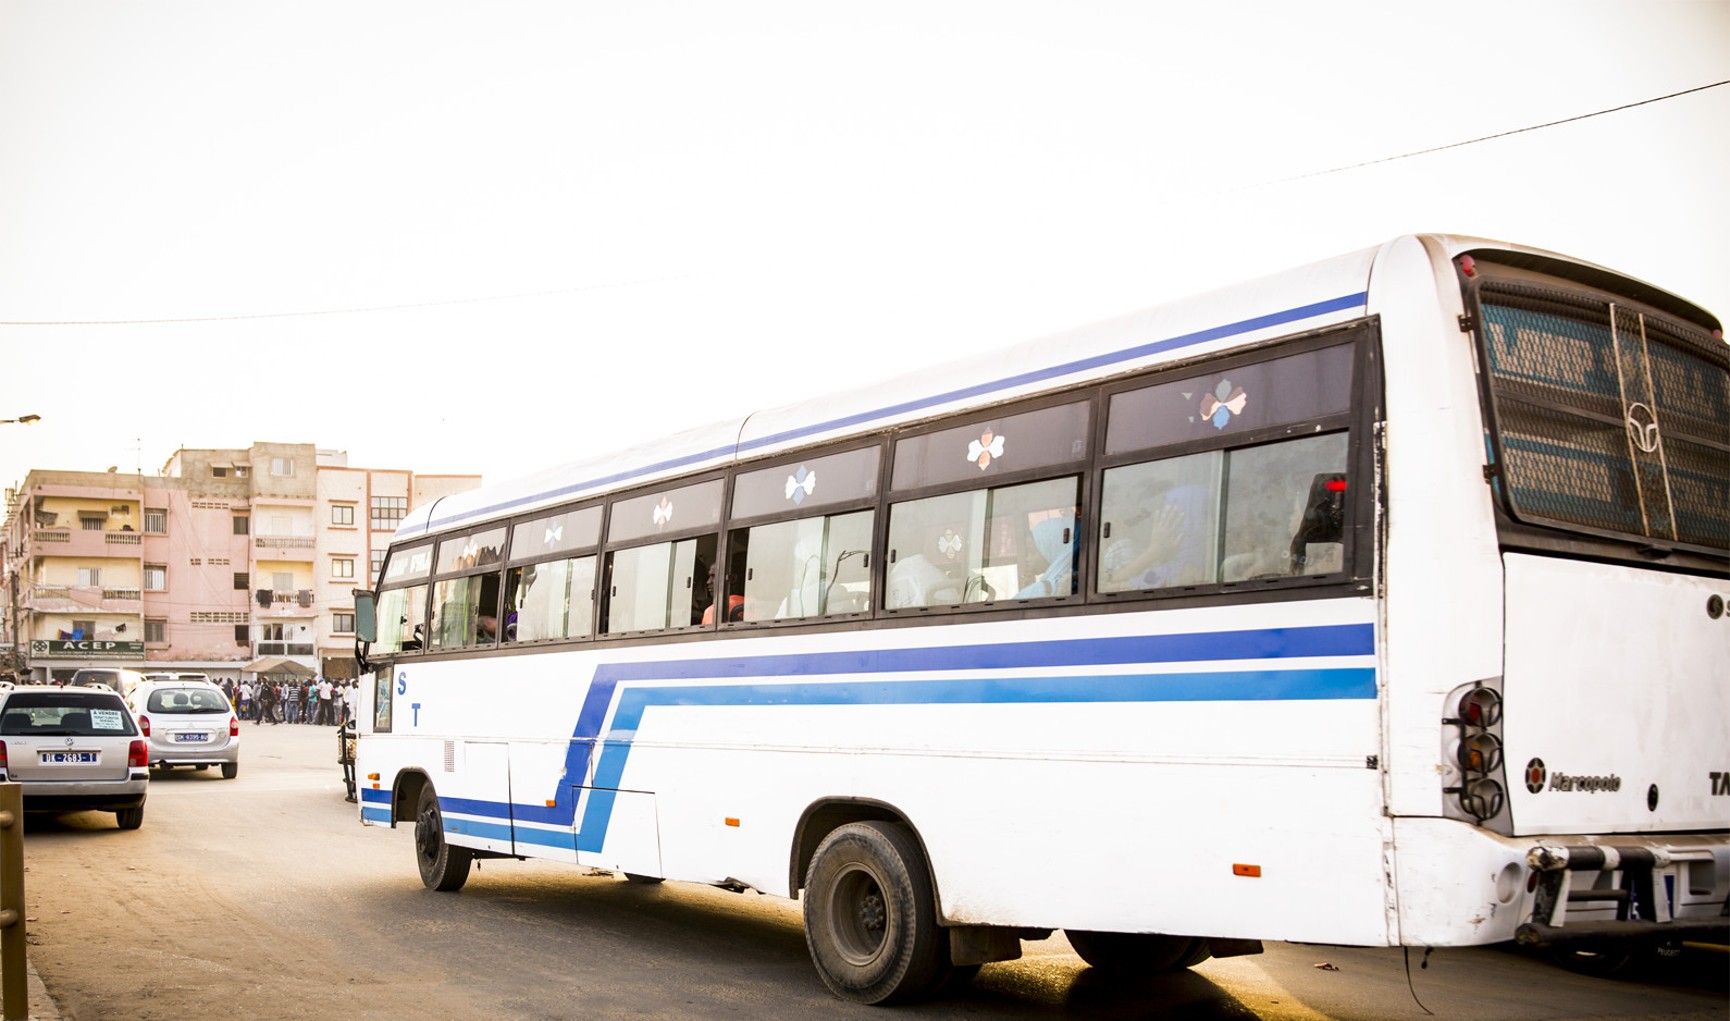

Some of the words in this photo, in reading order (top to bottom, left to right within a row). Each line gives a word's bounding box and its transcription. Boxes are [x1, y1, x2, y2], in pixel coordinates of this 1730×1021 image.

[63, 641, 117, 650] ACEP
[397, 671, 407, 696] S
[411, 702, 421, 727] T
[1548, 771, 1622, 795] Marcopolo
[1709, 771, 1730, 797] TA
